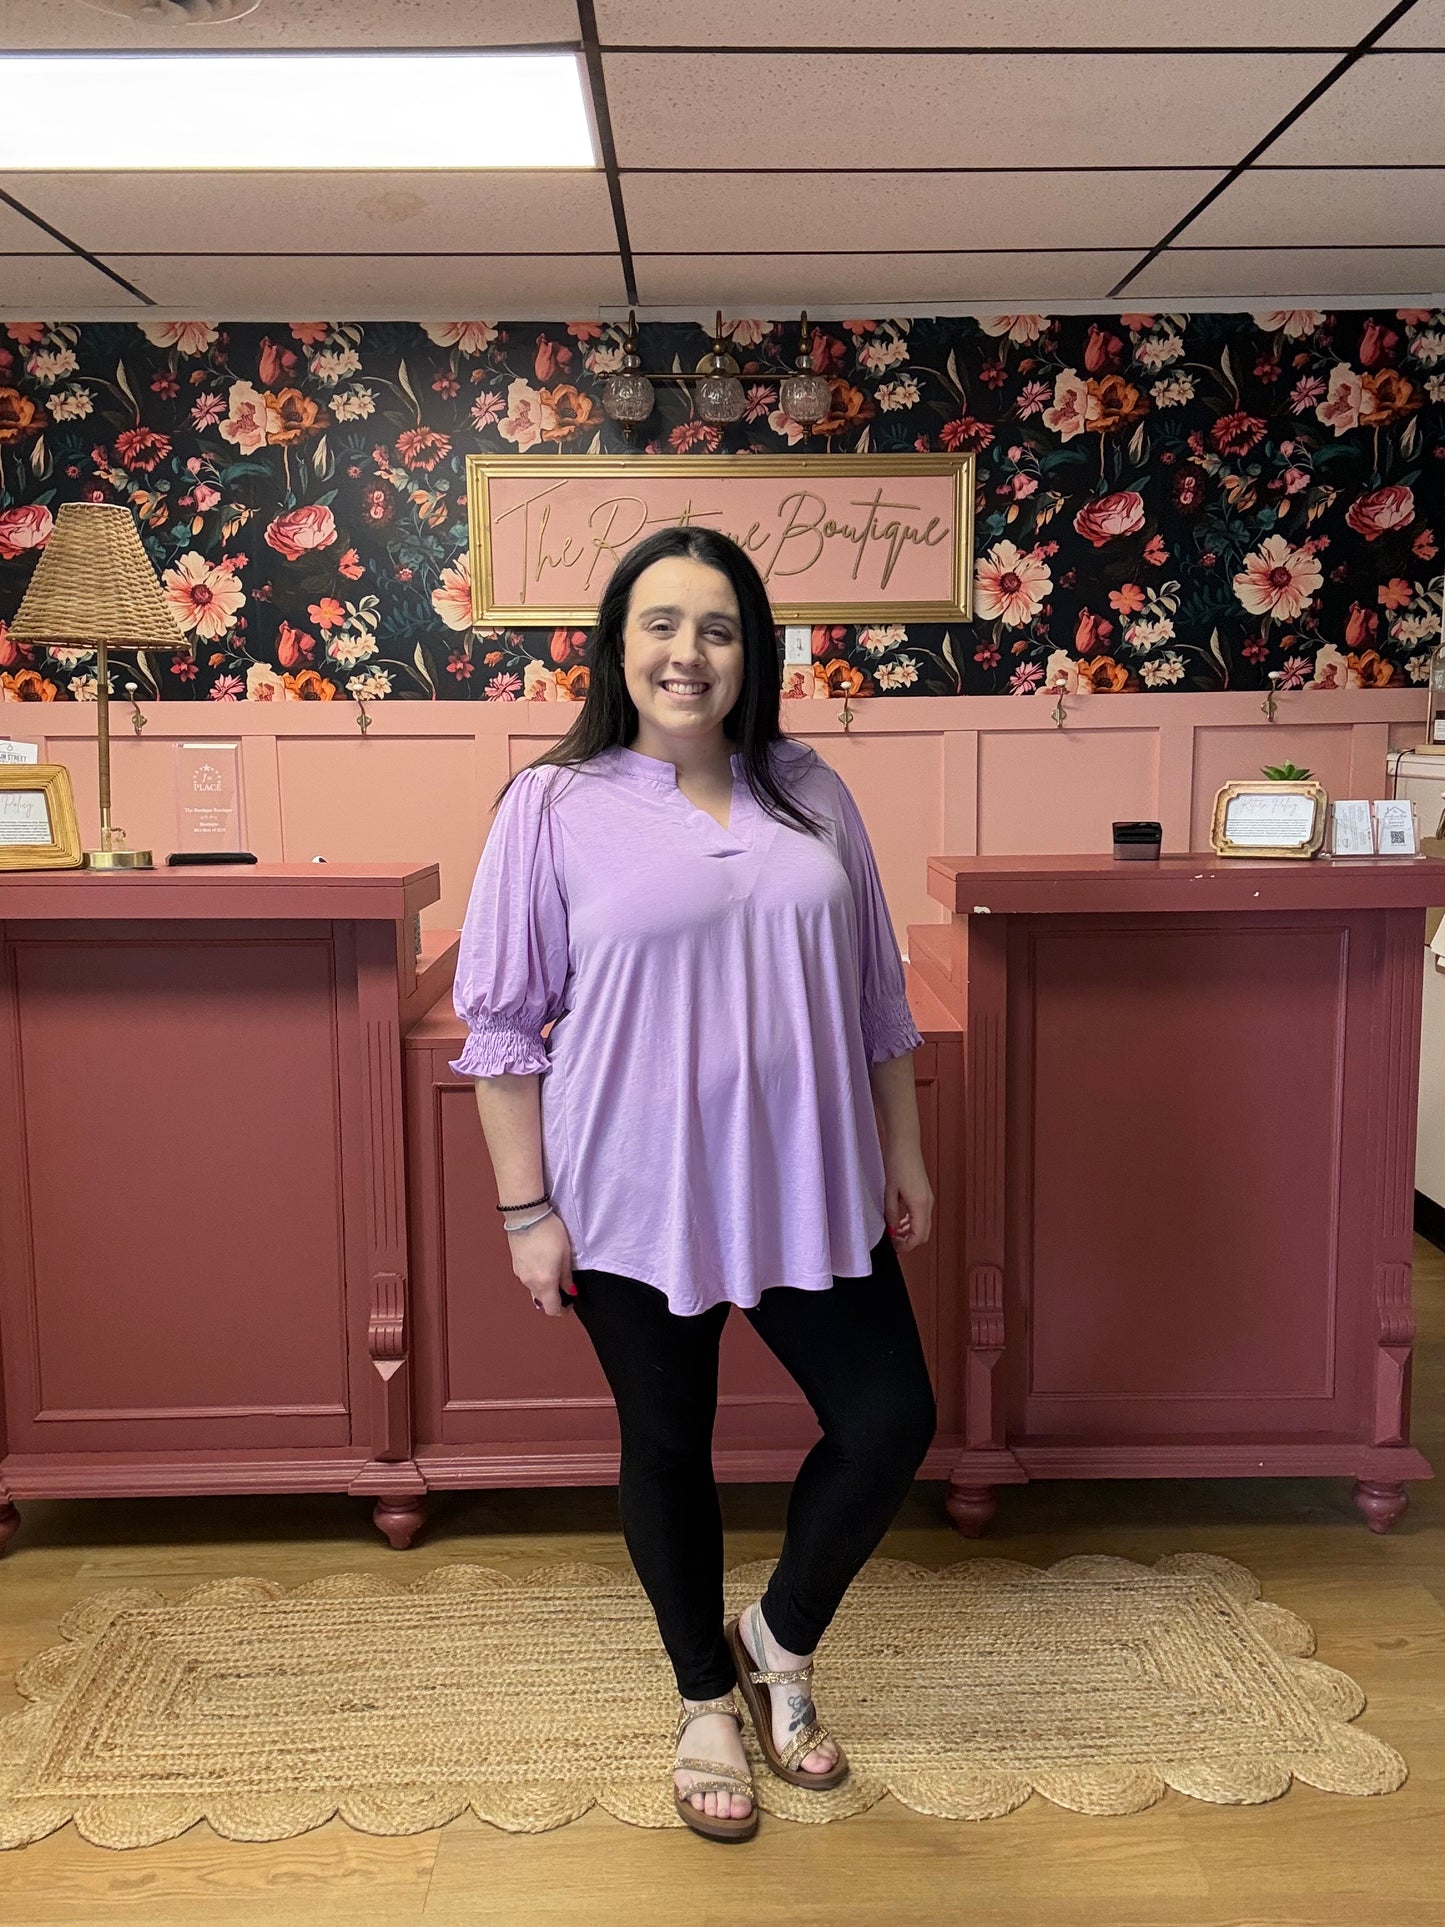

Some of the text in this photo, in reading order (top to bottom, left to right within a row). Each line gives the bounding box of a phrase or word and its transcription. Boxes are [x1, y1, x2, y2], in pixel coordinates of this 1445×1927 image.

[494, 479, 585, 605] The
[763, 487, 951, 590] Boutique
[193, 783, 223, 792] PLACE
